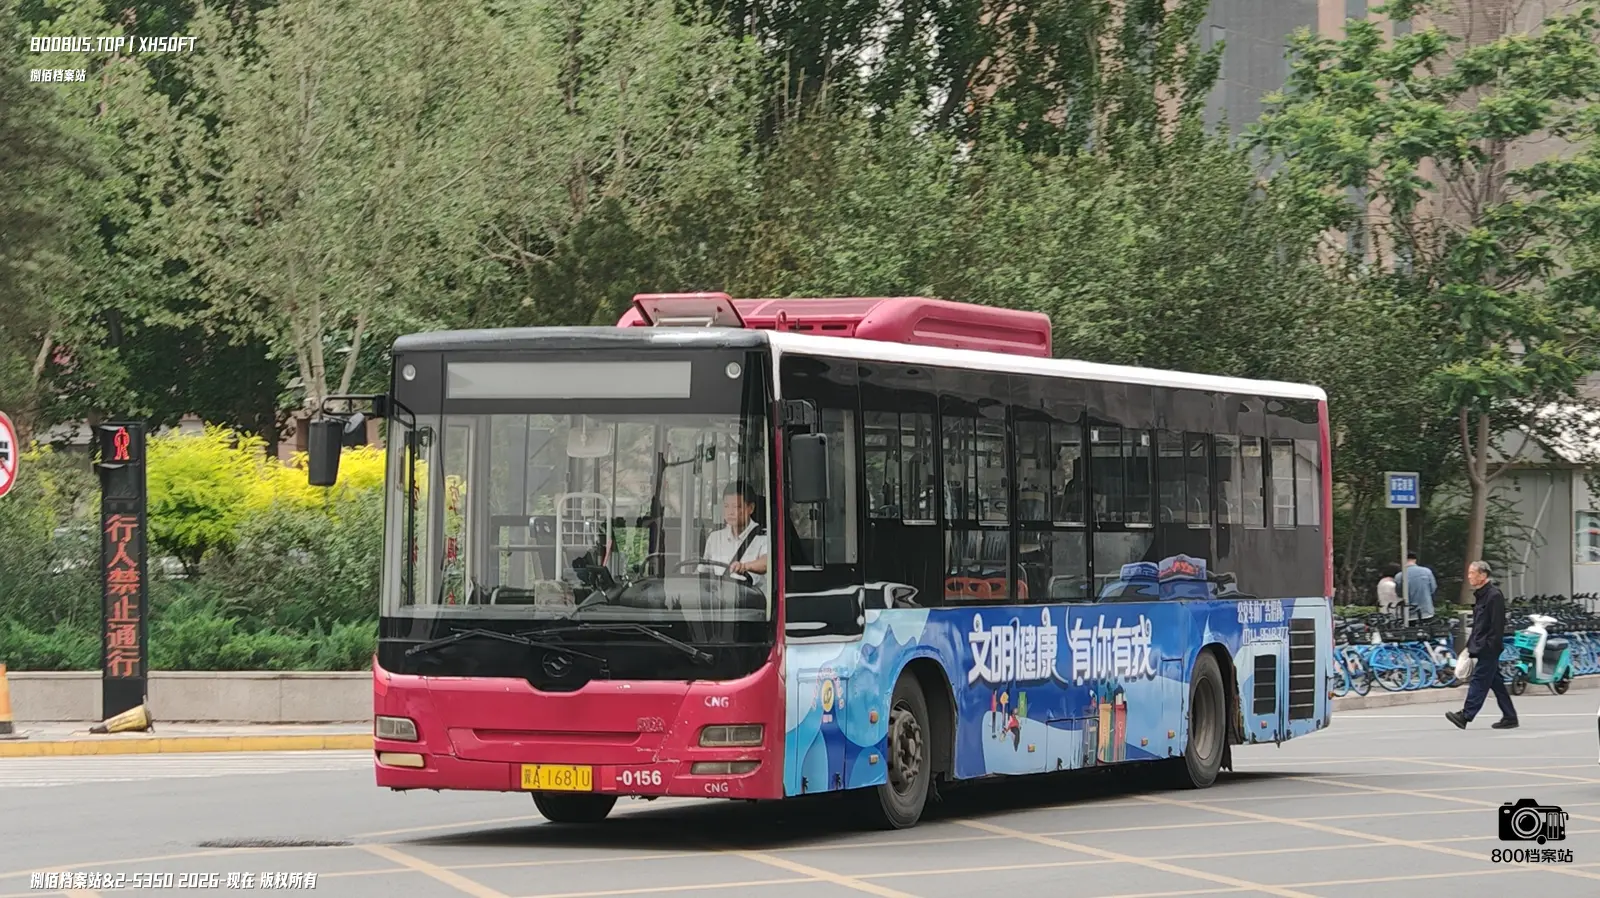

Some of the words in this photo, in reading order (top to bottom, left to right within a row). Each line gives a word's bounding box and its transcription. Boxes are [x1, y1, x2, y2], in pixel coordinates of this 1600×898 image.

[104, 513, 141, 678] 行人禁止通行
[968, 606, 1069, 686] 文明健康
[1069, 609, 1157, 685] 有你有我
[704, 695, 730, 708] CNG
[616, 770, 662, 786] -0156
[704, 781, 729, 794] CNG
